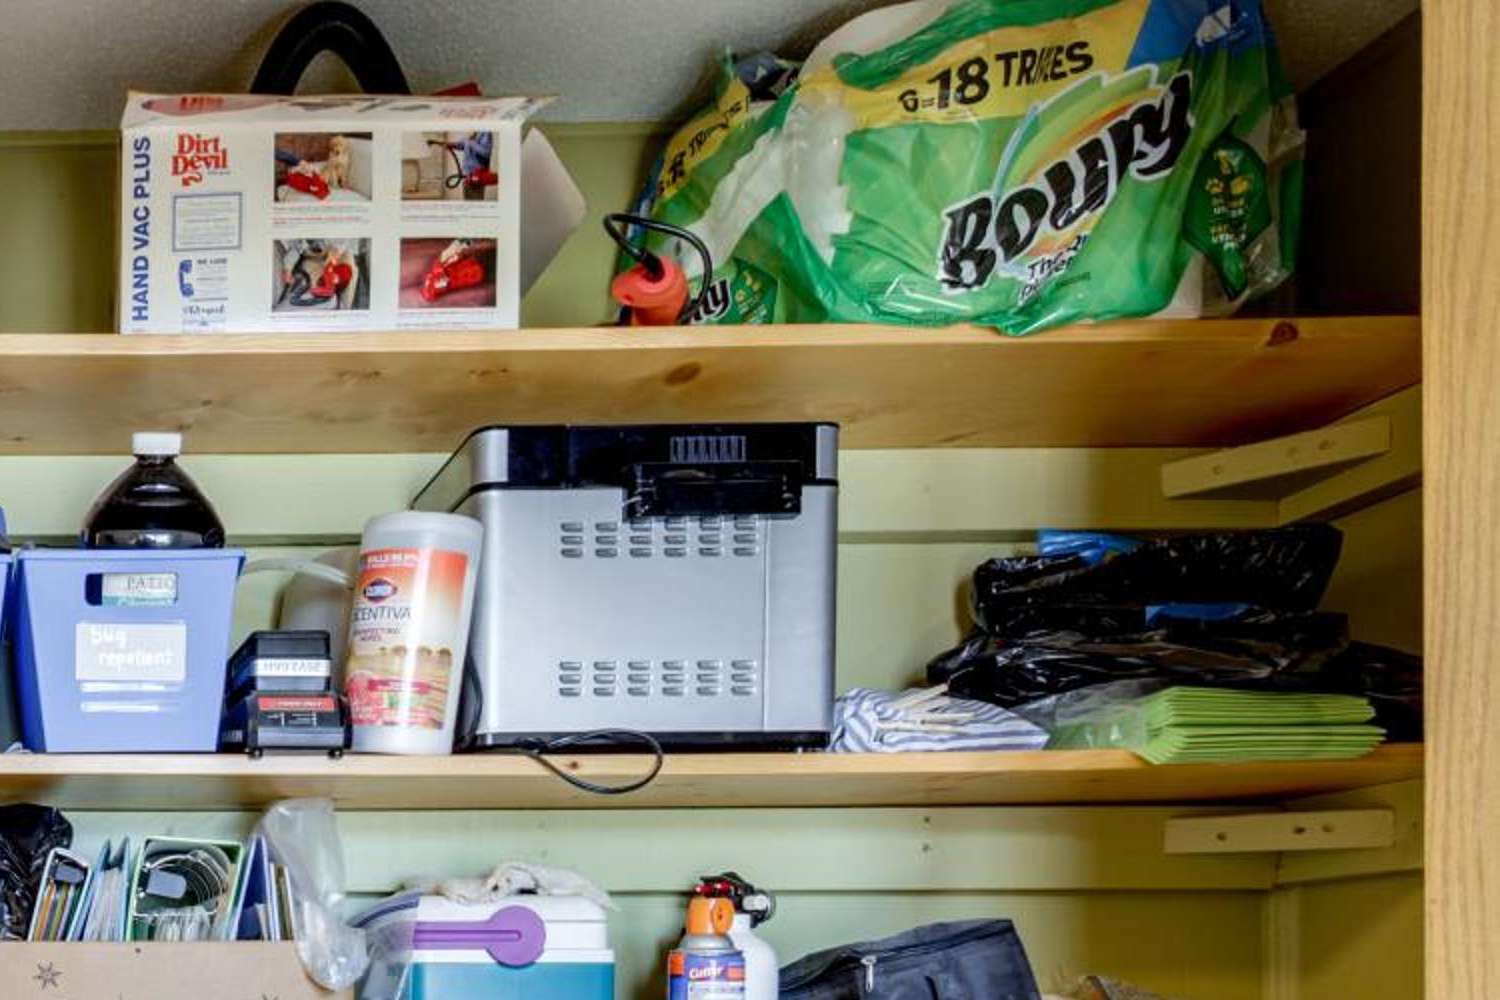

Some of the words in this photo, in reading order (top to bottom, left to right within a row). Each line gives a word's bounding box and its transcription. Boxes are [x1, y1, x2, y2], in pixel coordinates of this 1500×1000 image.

[996, 41, 1094, 87] TRES
[171, 148, 228, 176] Devil
[178, 132, 220, 154] Dirt
[133, 136, 151, 200] PLUS
[940, 71, 1192, 289] Bouny
[132, 205, 150, 251] VAC
[131, 256, 149, 322] HAND
[90, 625, 128, 649] bug
